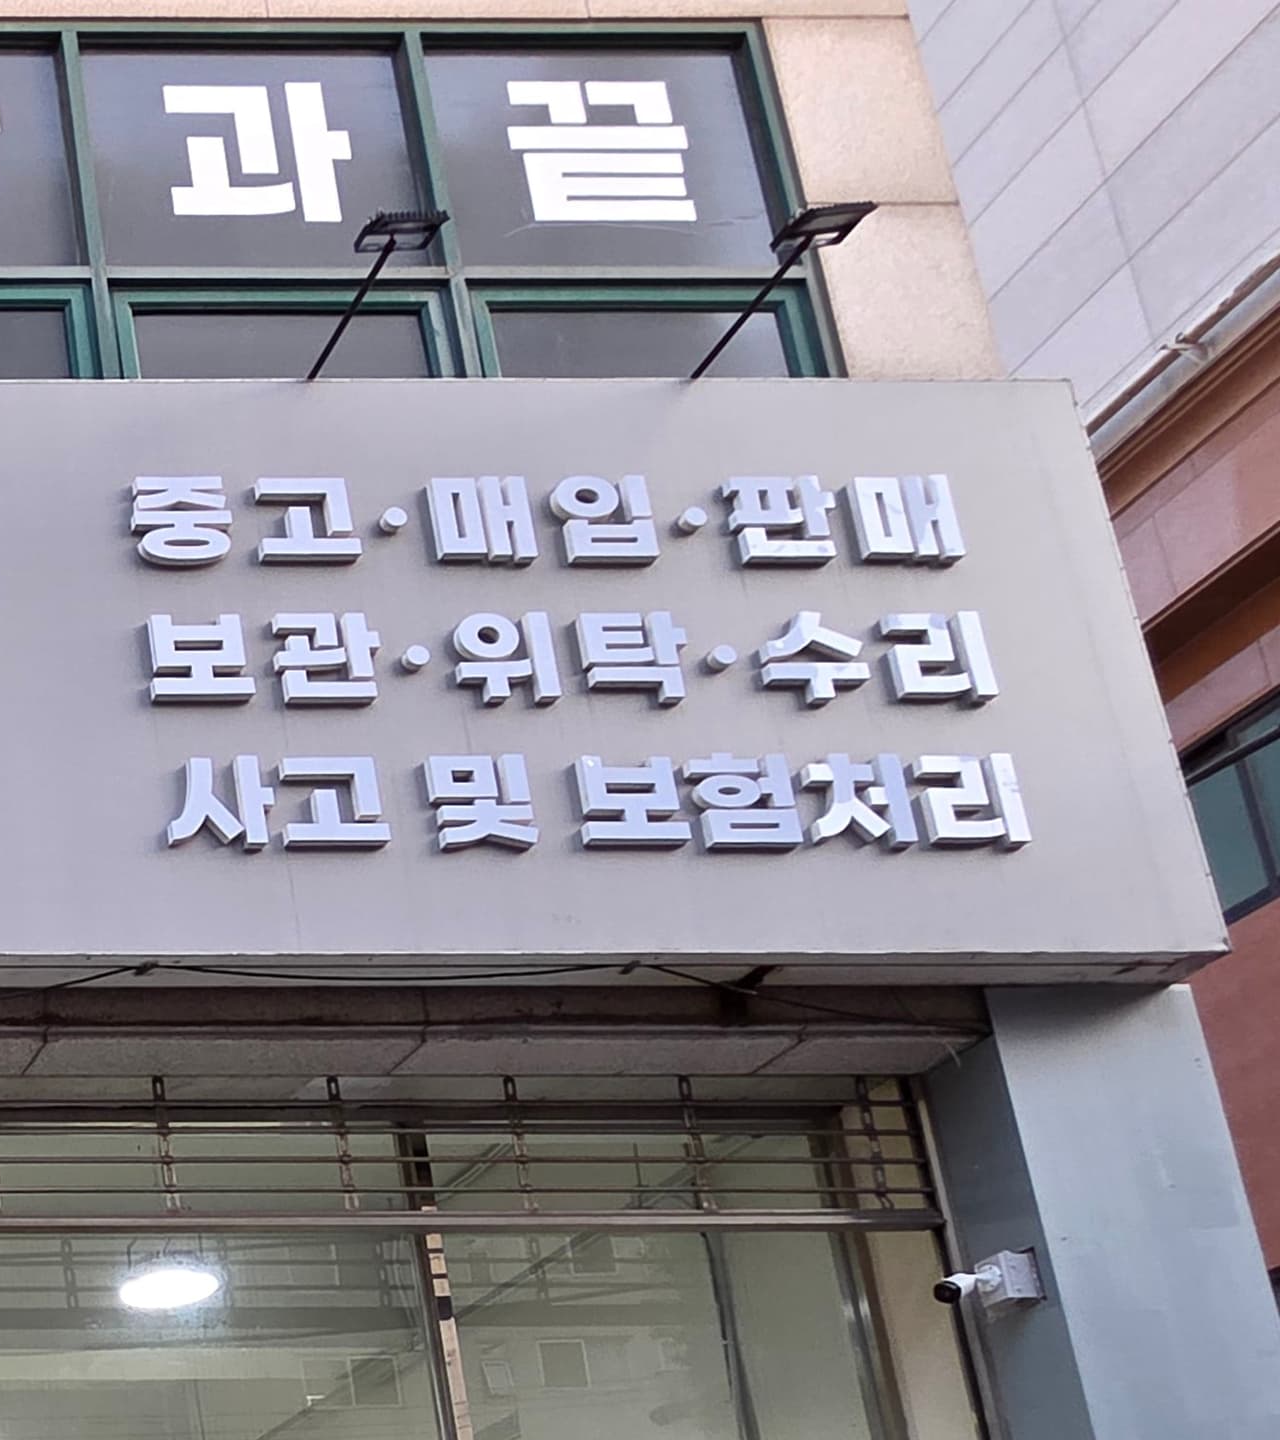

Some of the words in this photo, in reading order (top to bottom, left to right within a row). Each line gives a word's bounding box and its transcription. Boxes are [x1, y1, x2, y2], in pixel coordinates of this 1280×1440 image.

[167, 755, 391, 849] 사고
[425, 754, 539, 851] 및
[575, 753, 1032, 849] 보험처리
